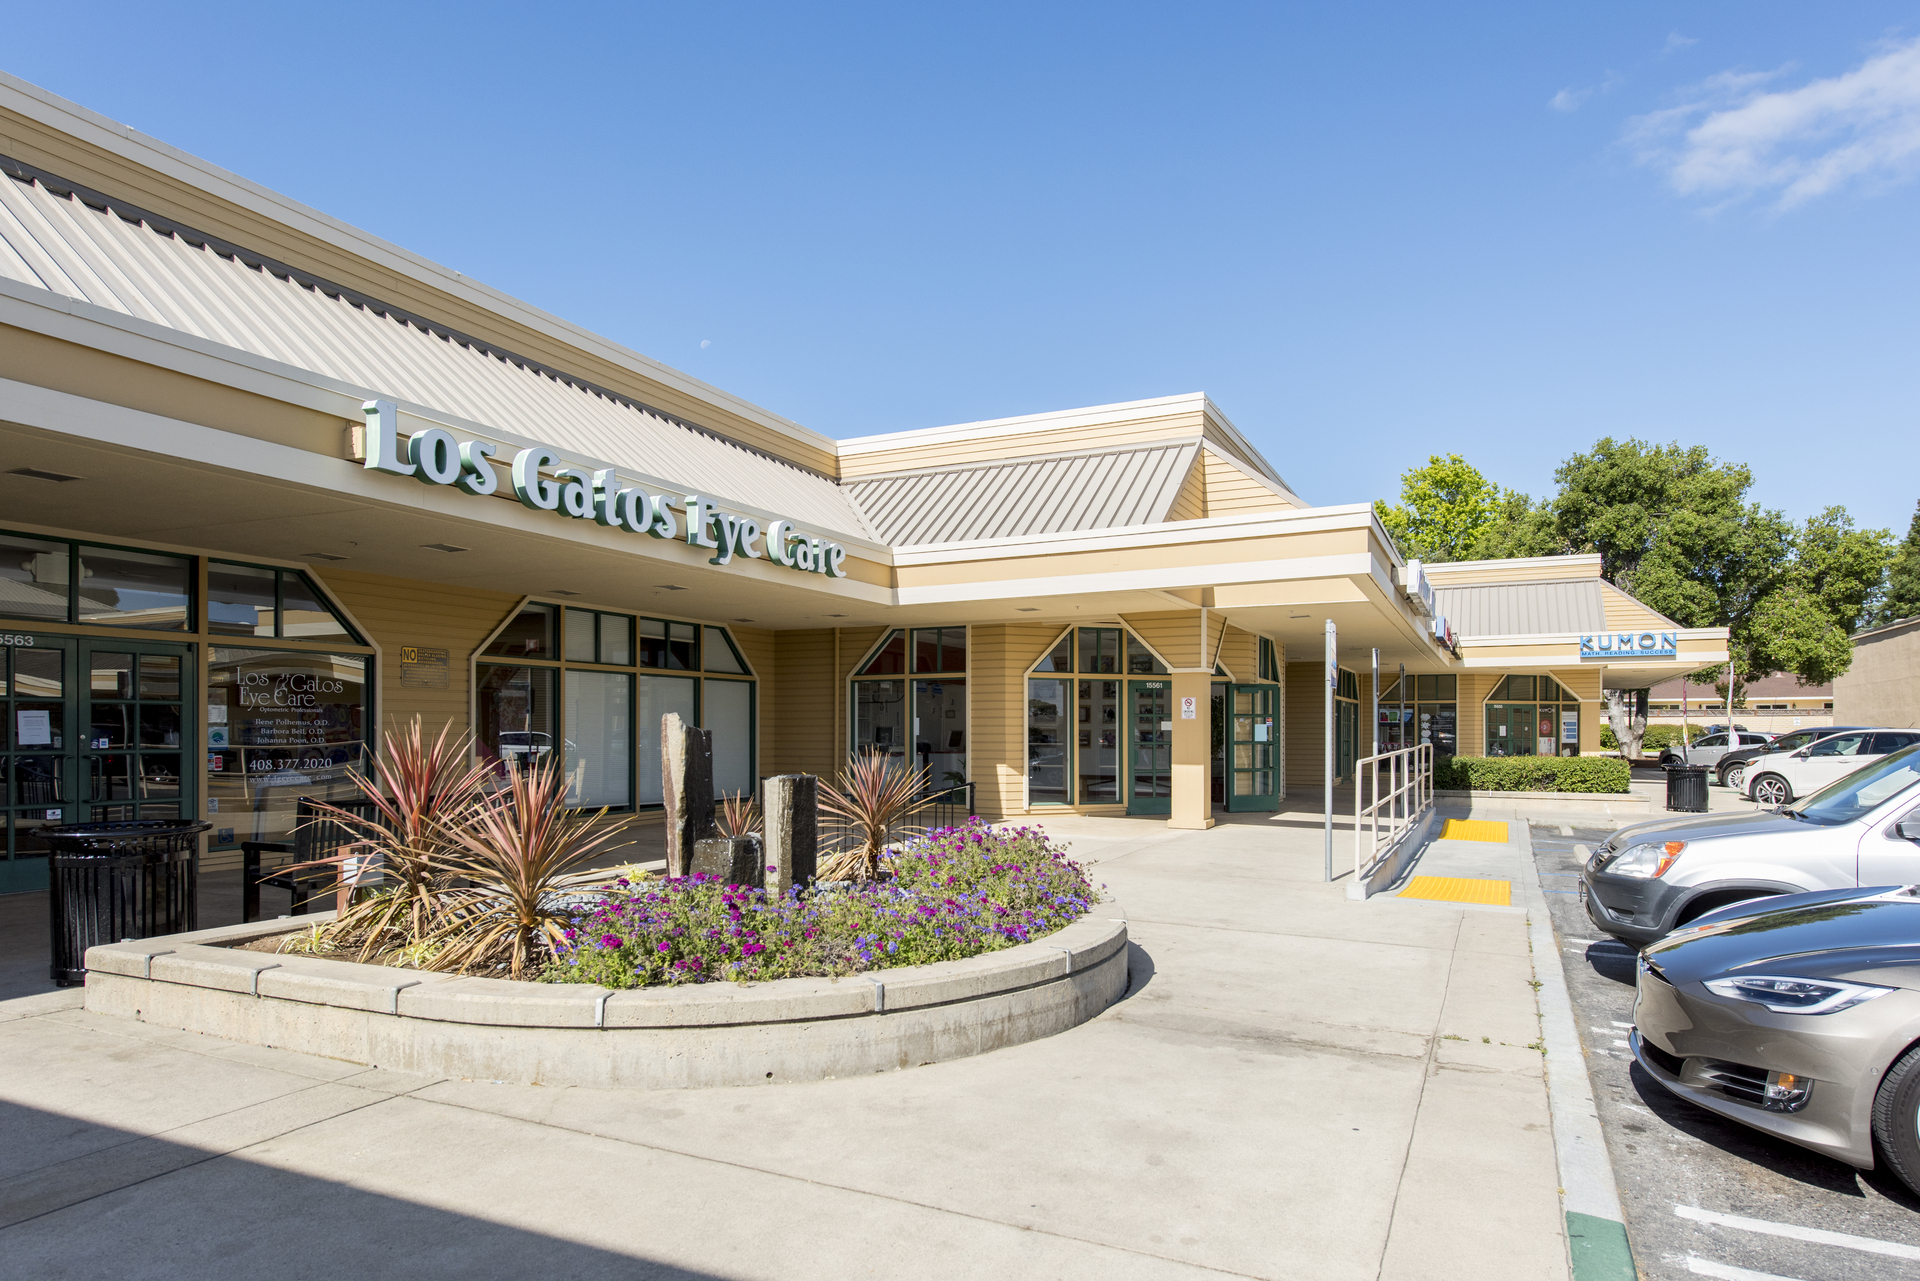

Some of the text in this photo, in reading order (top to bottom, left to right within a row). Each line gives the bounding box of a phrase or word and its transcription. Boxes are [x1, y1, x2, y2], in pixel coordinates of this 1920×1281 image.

[361, 398, 848, 578] Los Gatos Eye Care
[1579, 632, 1677, 650] KUMON
[404, 648, 416, 661] NO
[236, 666, 344, 694] Los Gatos
[239, 686, 316, 711] Eye Care
[275, 718, 312, 726] Polhemus,
[256, 737, 287, 745] Johanna
[249, 758, 332, 771] 408.377.2020
